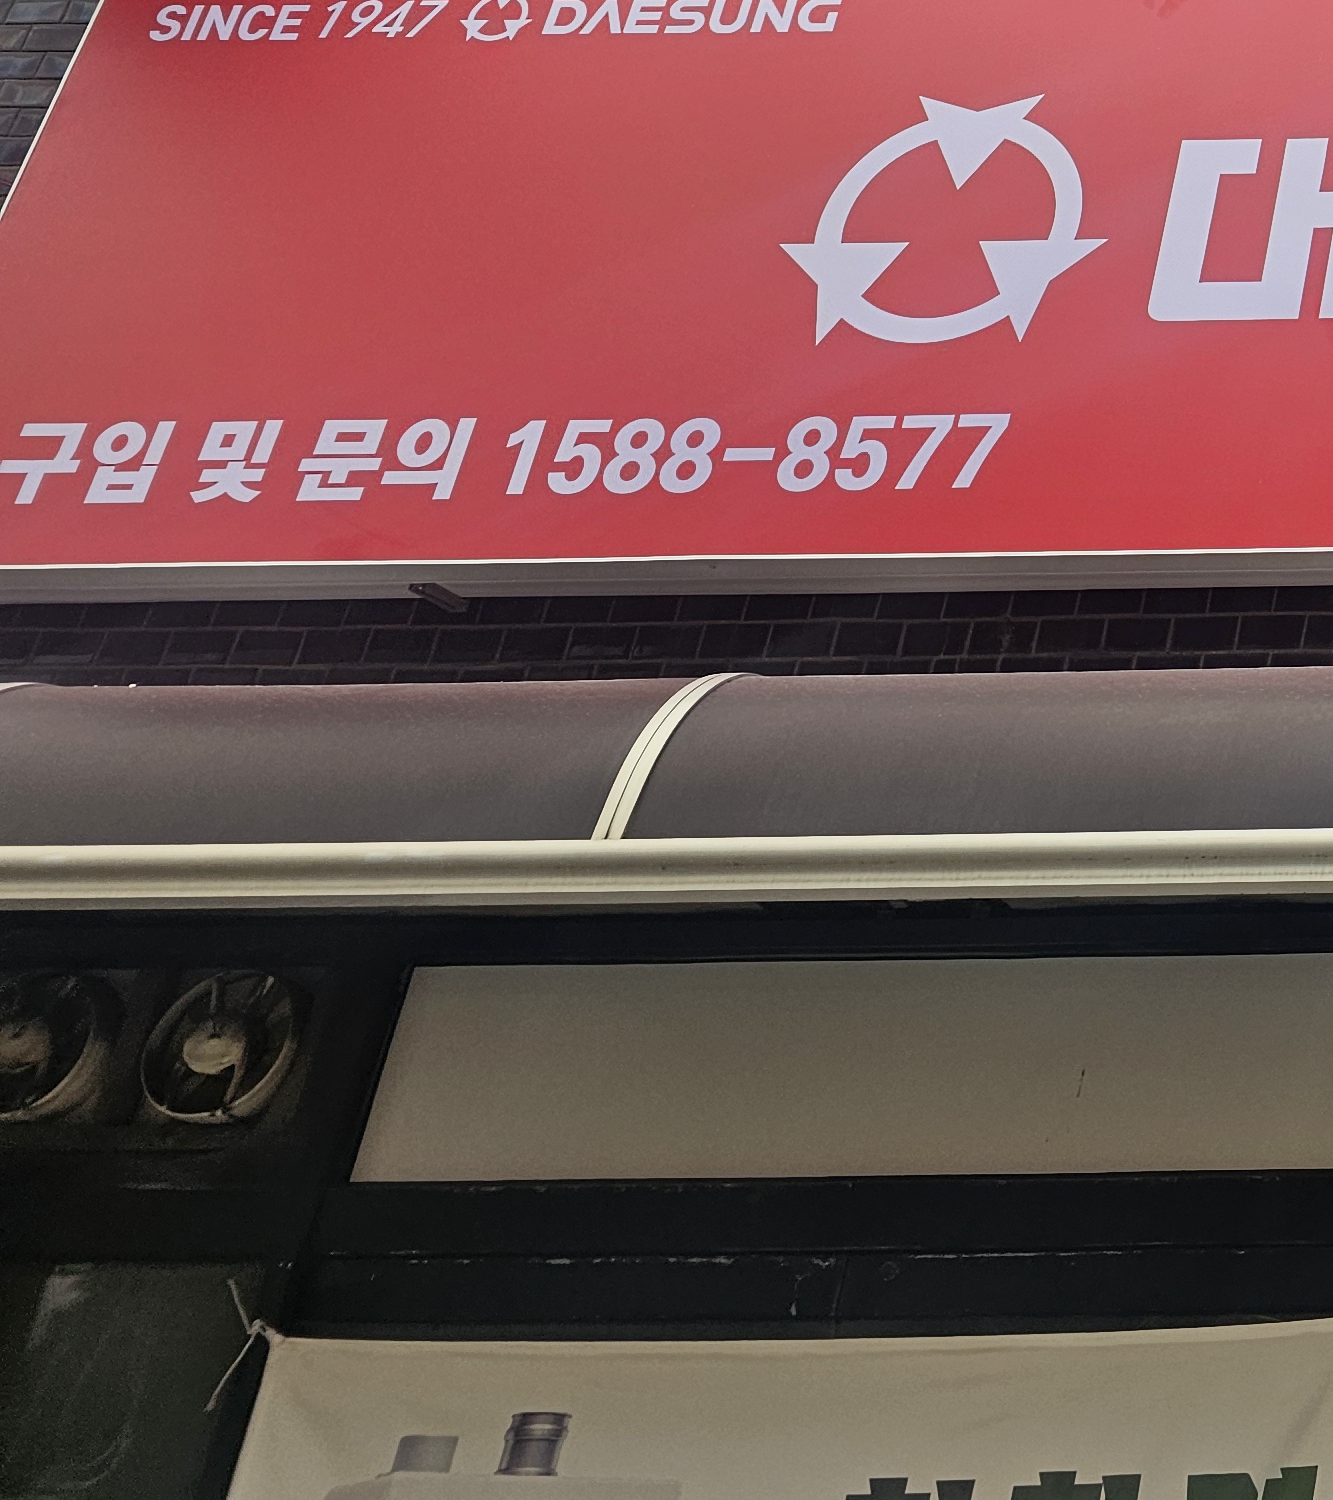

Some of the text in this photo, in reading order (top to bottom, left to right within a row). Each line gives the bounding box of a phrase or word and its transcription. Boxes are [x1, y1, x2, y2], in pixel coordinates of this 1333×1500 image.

[149, 4, 311, 42] SINCE
[318, 0, 450, 40] 1947
[0, 413, 1012, 504] 구입 및 문의 1588-8577
